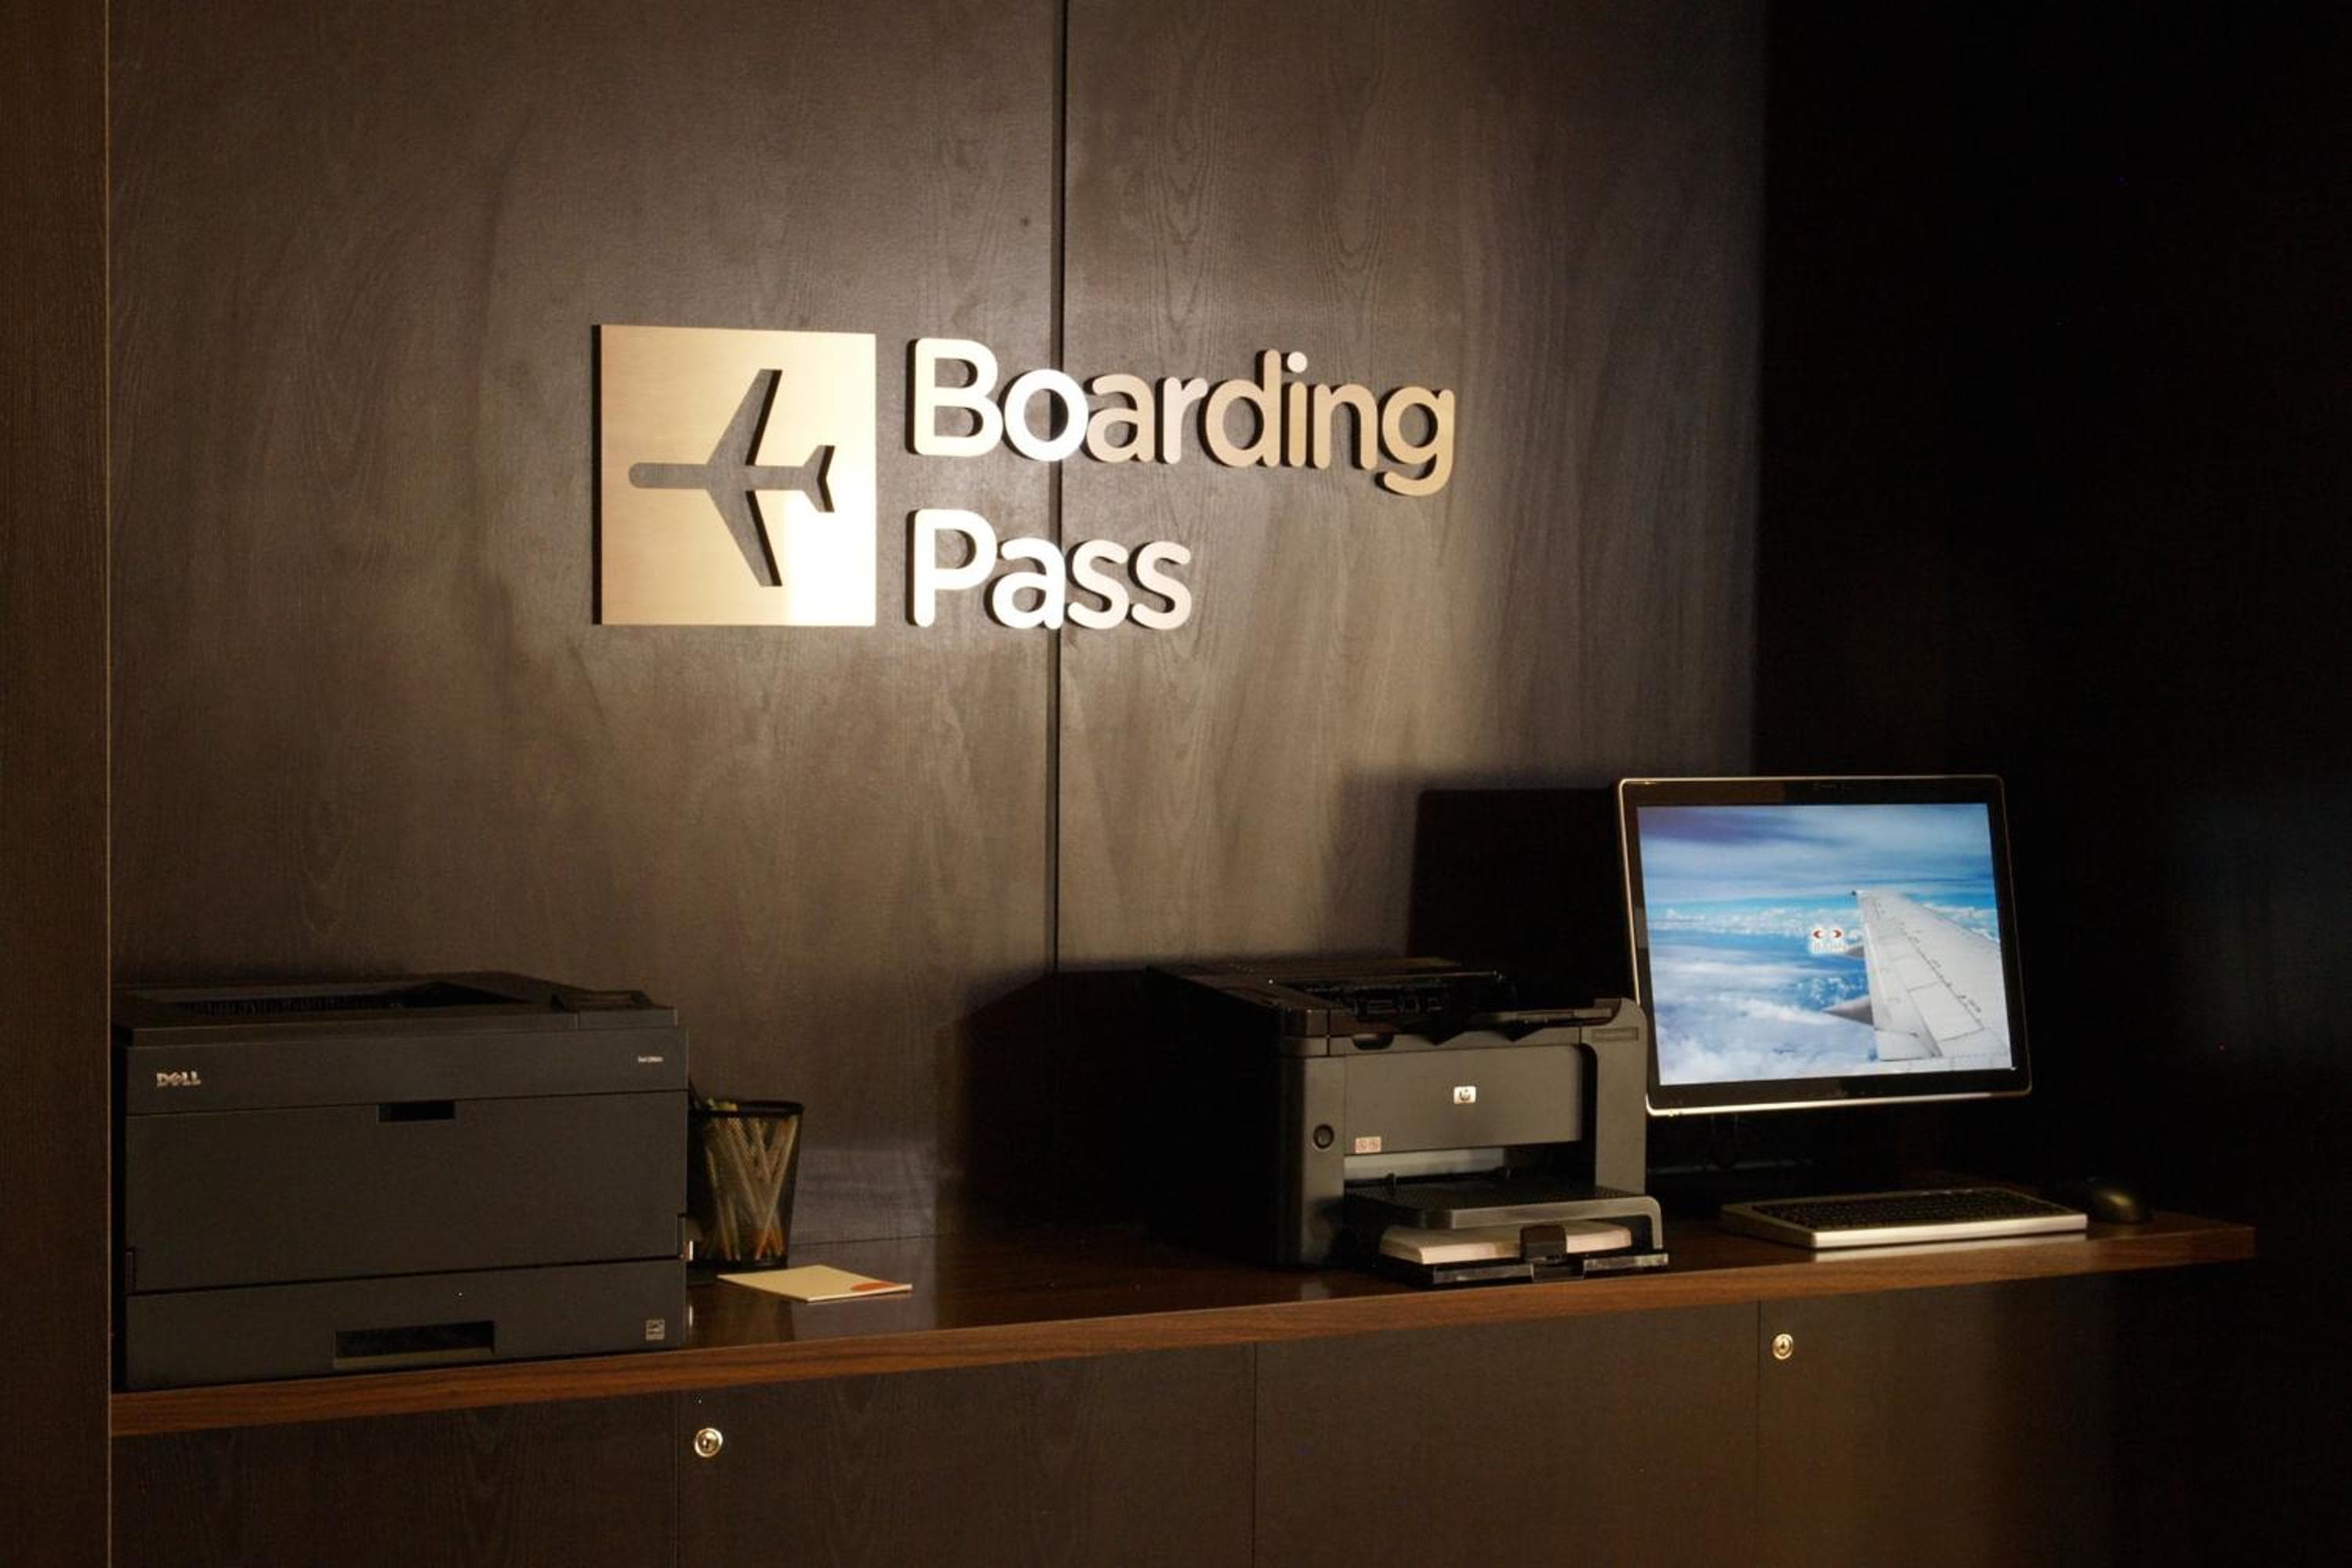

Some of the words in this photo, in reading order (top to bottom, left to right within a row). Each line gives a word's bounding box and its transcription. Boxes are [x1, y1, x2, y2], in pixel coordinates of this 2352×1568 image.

[909, 337, 1456, 496] Boarding
[909, 508, 1192, 630] Pass
[156, 1071, 201, 1087] DELL
